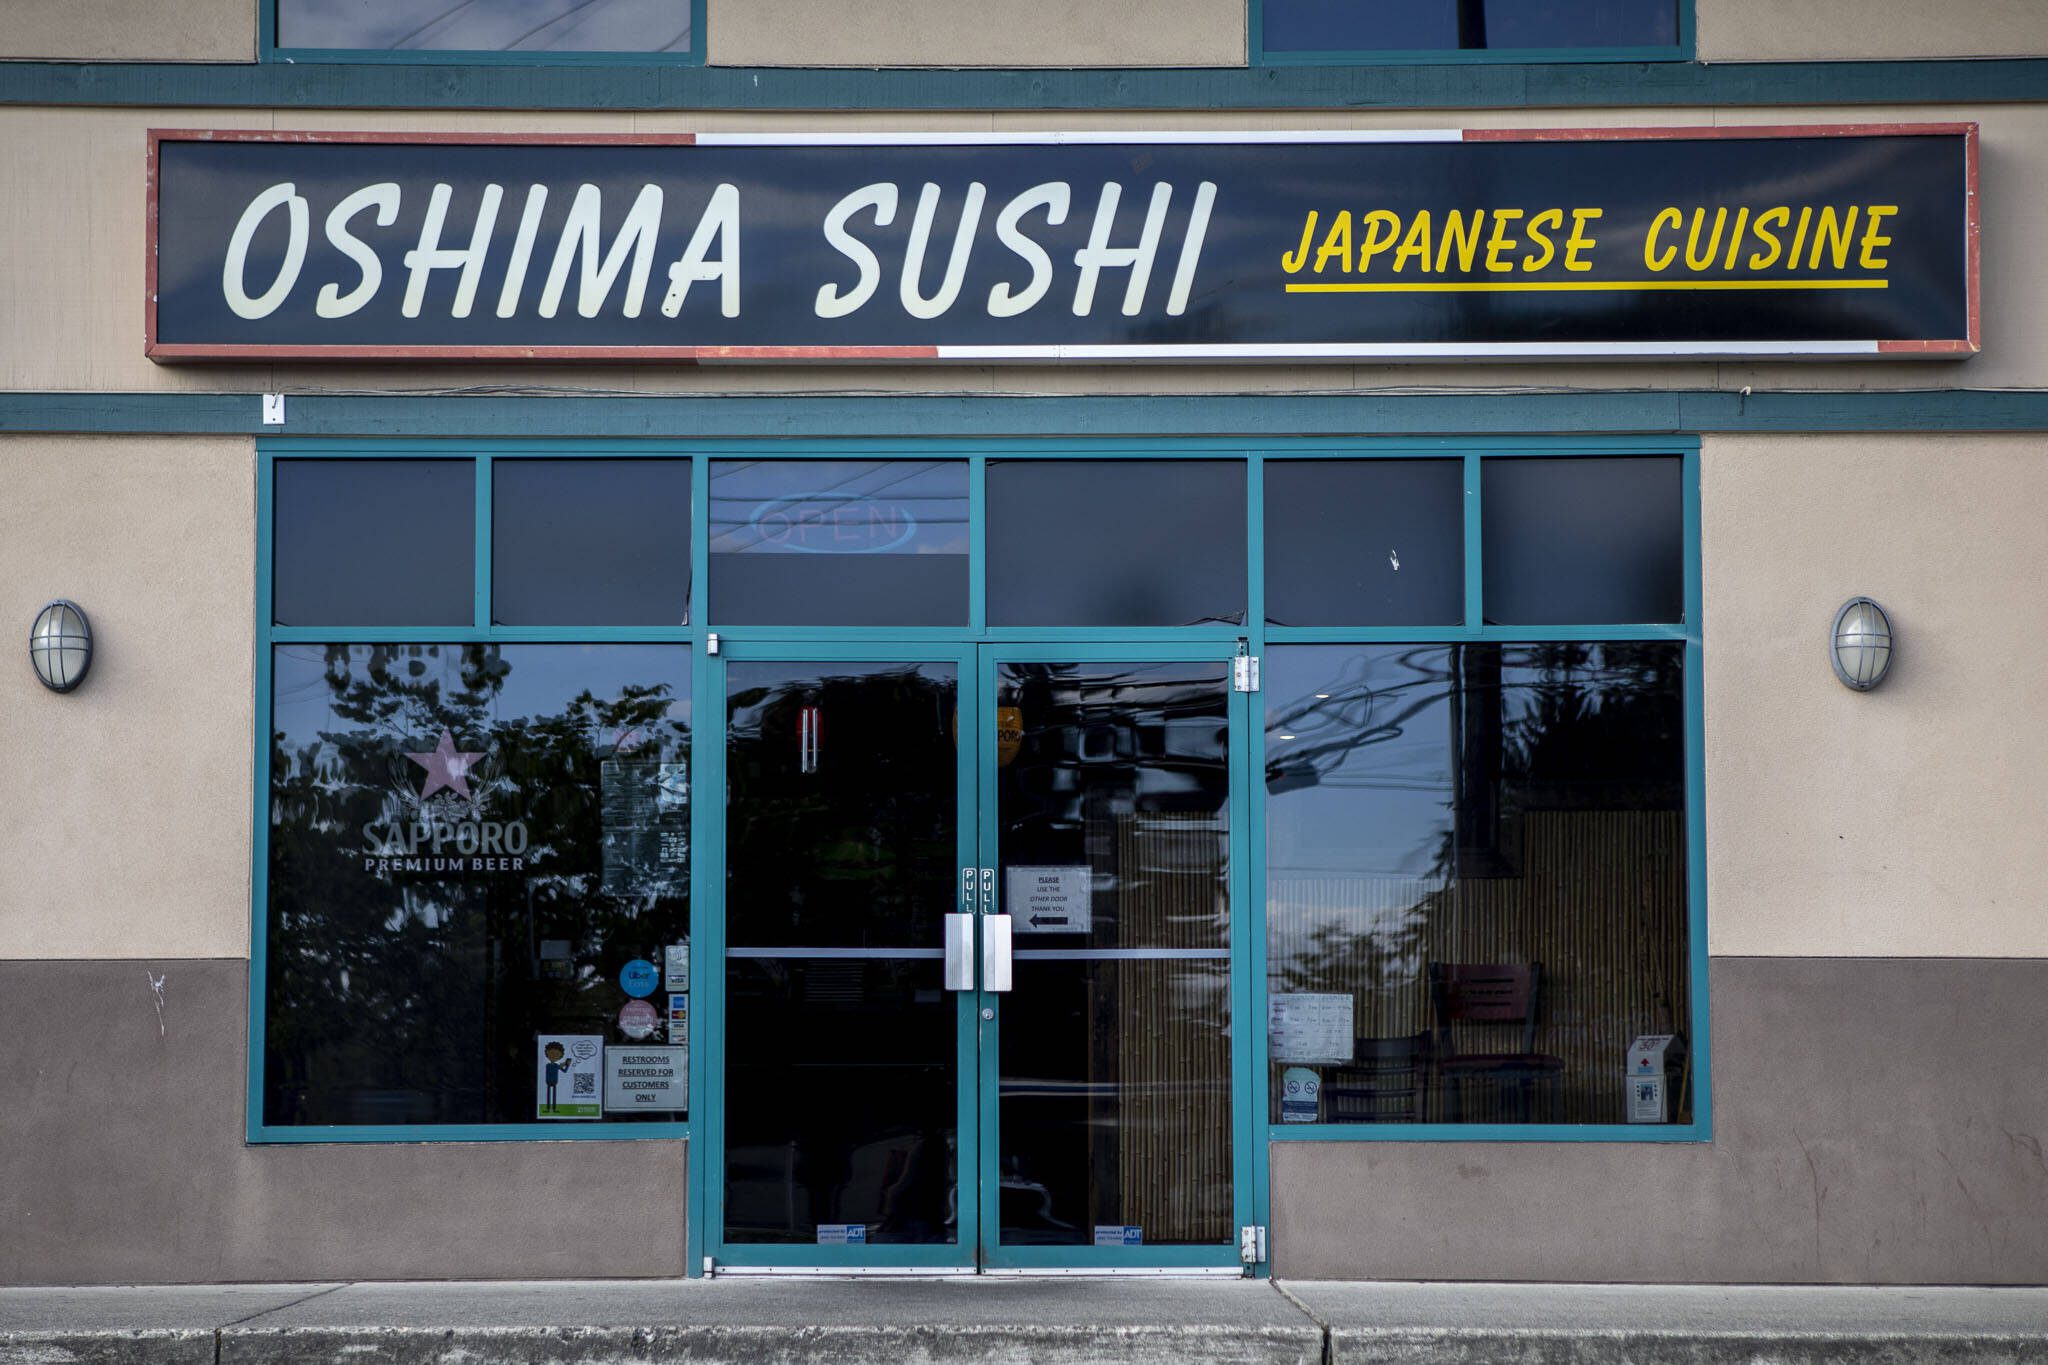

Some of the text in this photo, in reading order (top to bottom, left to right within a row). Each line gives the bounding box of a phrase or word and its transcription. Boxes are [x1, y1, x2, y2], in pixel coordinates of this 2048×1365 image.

[1281, 205, 1898, 274] JAPANESE CUISINE
[222, 181, 1218, 320] OSHIMA SUSHI
[759, 505, 898, 543] OPEN
[362, 821, 529, 855] SAPPORO
[364, 857, 525, 872] PREMIUM BEER
[1038, 876, 1060, 884] PLEASE
[966, 870, 974, 913] PULL
[983, 871, 991, 913] PULL
[628, 971, 650, 980] Uber
[618, 1068, 674, 1076] RESERVED FOR
[622, 1081, 670, 1089] CUSTOMERS
[635, 1093, 656, 1101] ONLY
[847, 1228, 865, 1238] ADT
[1124, 1229, 1142, 1239] ADT
